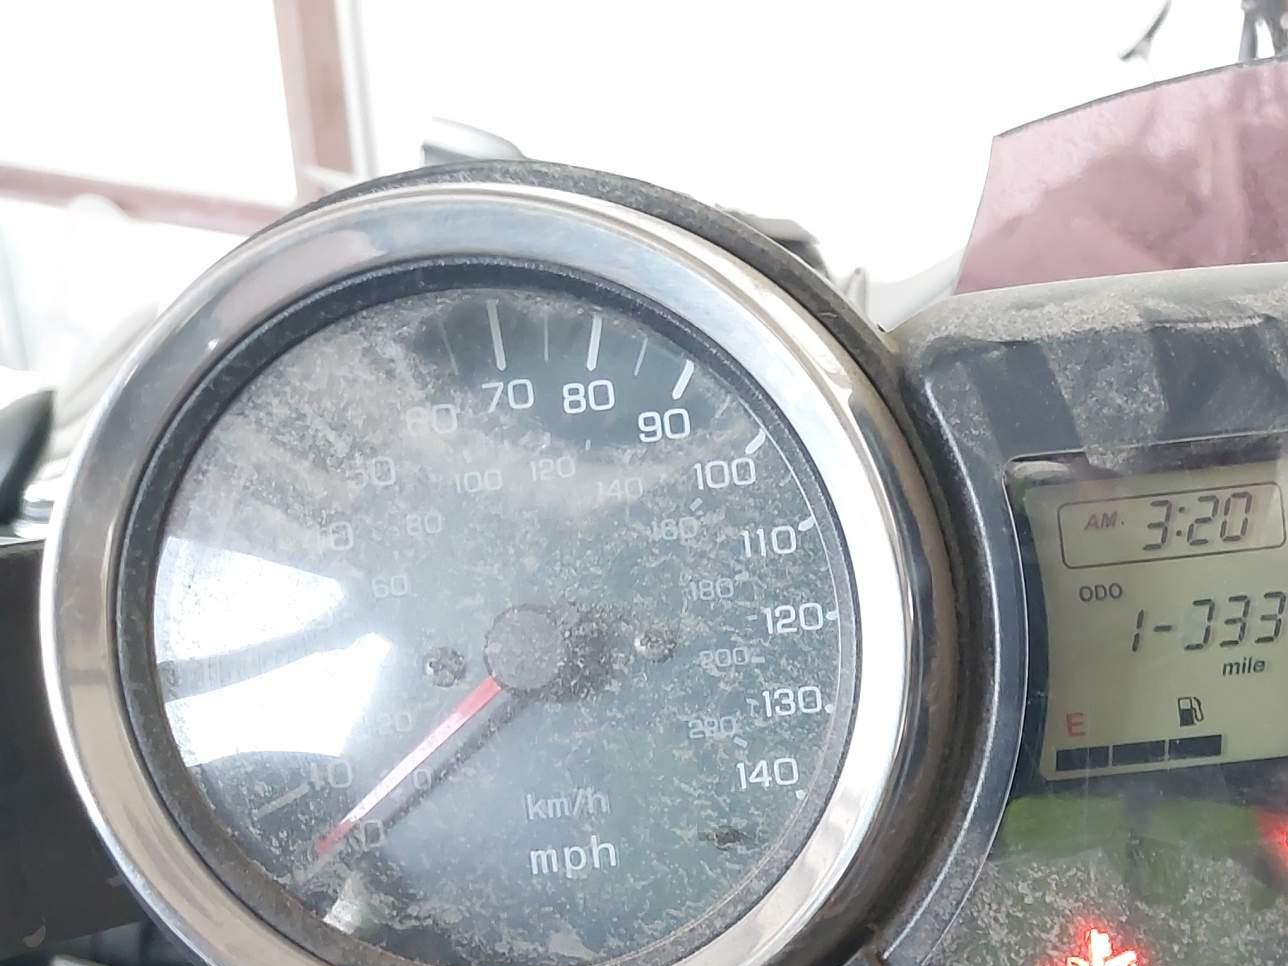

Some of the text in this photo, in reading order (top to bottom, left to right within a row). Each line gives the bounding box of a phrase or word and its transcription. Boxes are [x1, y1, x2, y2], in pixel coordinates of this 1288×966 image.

[481, 378, 535, 413] 70
[562, 378, 616, 415] 80
[637, 408, 691, 443] 90
[454, 468, 504, 495] 100
[530, 455, 577, 482] 120
[693, 457, 757, 490] 100
[596, 477, 644, 501] 140
[405, 509, 445, 537] 80
[1083, 511, 1119, 532] AM
[1142, 490, 1254, 552] 3:20
[740, 524, 798, 557] 110
[371, 574, 409, 599] 60
[689, 576, 735, 602] 180
[1078, 582, 1124, 603] ODO
[763, 602, 825, 635] 120
[699, 646, 750, 669] 200
[1221, 655, 1266, 677] mile
[762, 685, 823, 718] 130
[1065, 711, 1087, 737] E
[736, 757, 800, 791] 140
[525, 786, 611, 821] km/h
[528, 834, 618, 880] mph
